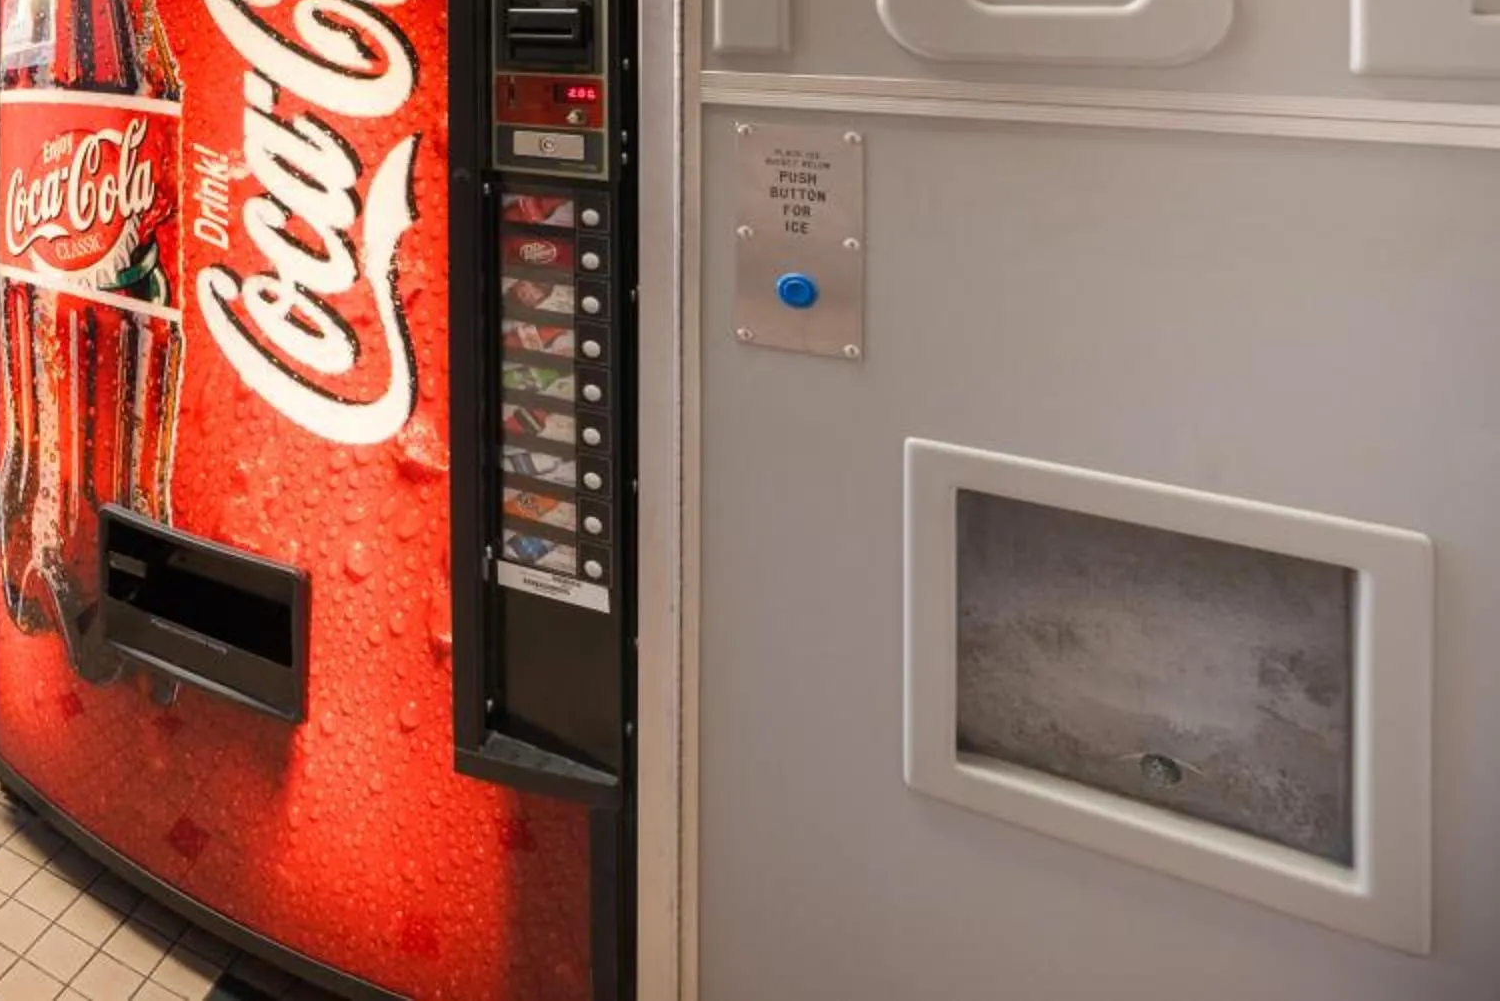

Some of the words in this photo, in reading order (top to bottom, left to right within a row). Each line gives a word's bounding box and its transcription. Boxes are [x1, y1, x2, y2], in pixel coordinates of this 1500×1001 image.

[5, 115, 155, 256] Coca-Cola
[779, 170, 818, 186] PUSH
[193, 143, 229, 250] Drink!
[769, 186, 827, 203] BUTTON
[783, 204, 812, 217] FOR
[785, 220, 810, 235] ICE
